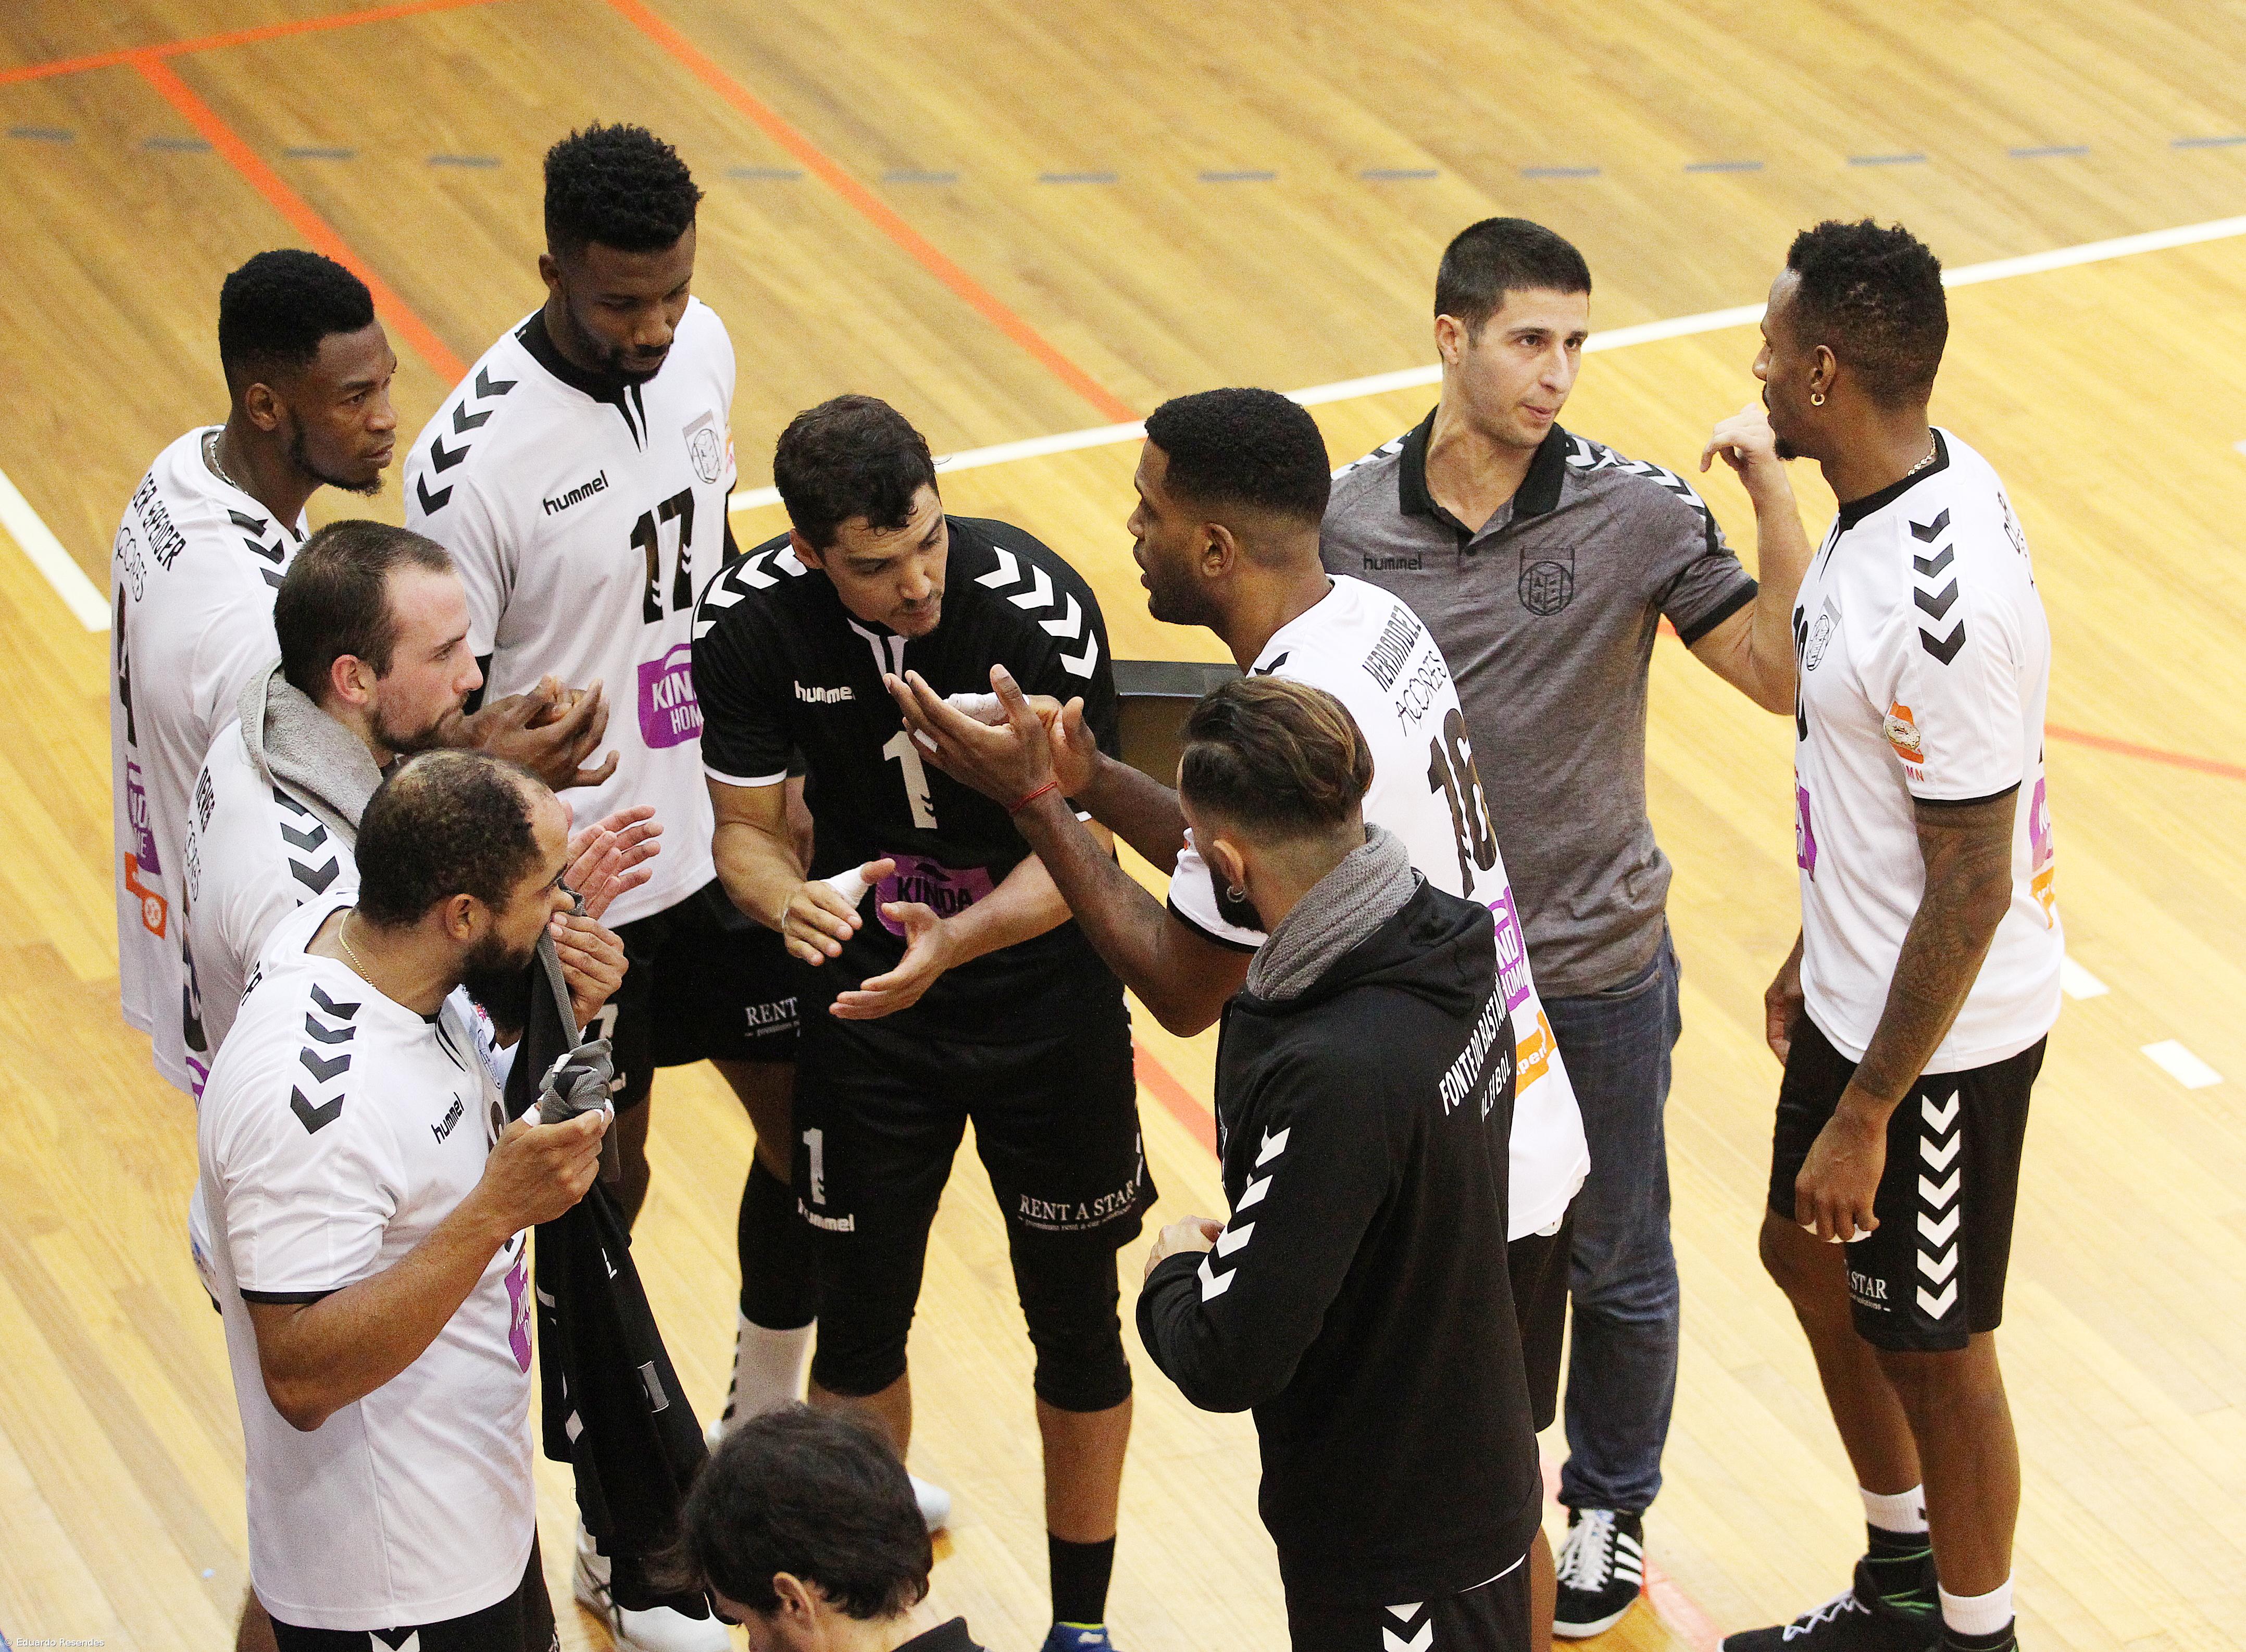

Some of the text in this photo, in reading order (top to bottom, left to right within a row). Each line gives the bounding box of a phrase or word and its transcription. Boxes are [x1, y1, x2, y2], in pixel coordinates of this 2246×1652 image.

[543, 469, 609, 516] hummel
[630, 486, 695, 625] 17
[1363, 551, 1423, 570] hummel
[1362, 604, 1421, 693] HERNANDEZ
[652, 670, 698, 712] KIN
[794, 680, 856, 704] humme
[670, 704, 705, 735] HOM
[882, 730, 938, 829] 1
[1427, 708, 1497, 900] 16
[745, 996, 797, 1026] RENT
[1438, 1044, 1479, 1117] FONTE
[1469, 1028, 1484, 1072] DO
[431, 1091, 465, 1145] hummel
[802, 1127, 826, 1206] 1
[1018, 1193, 1071, 1221] RENT
[1075, 1202, 1090, 1220] A
[1093, 1179, 1135, 1217] STAR
[1851, 1271, 1889, 1300] STAR
